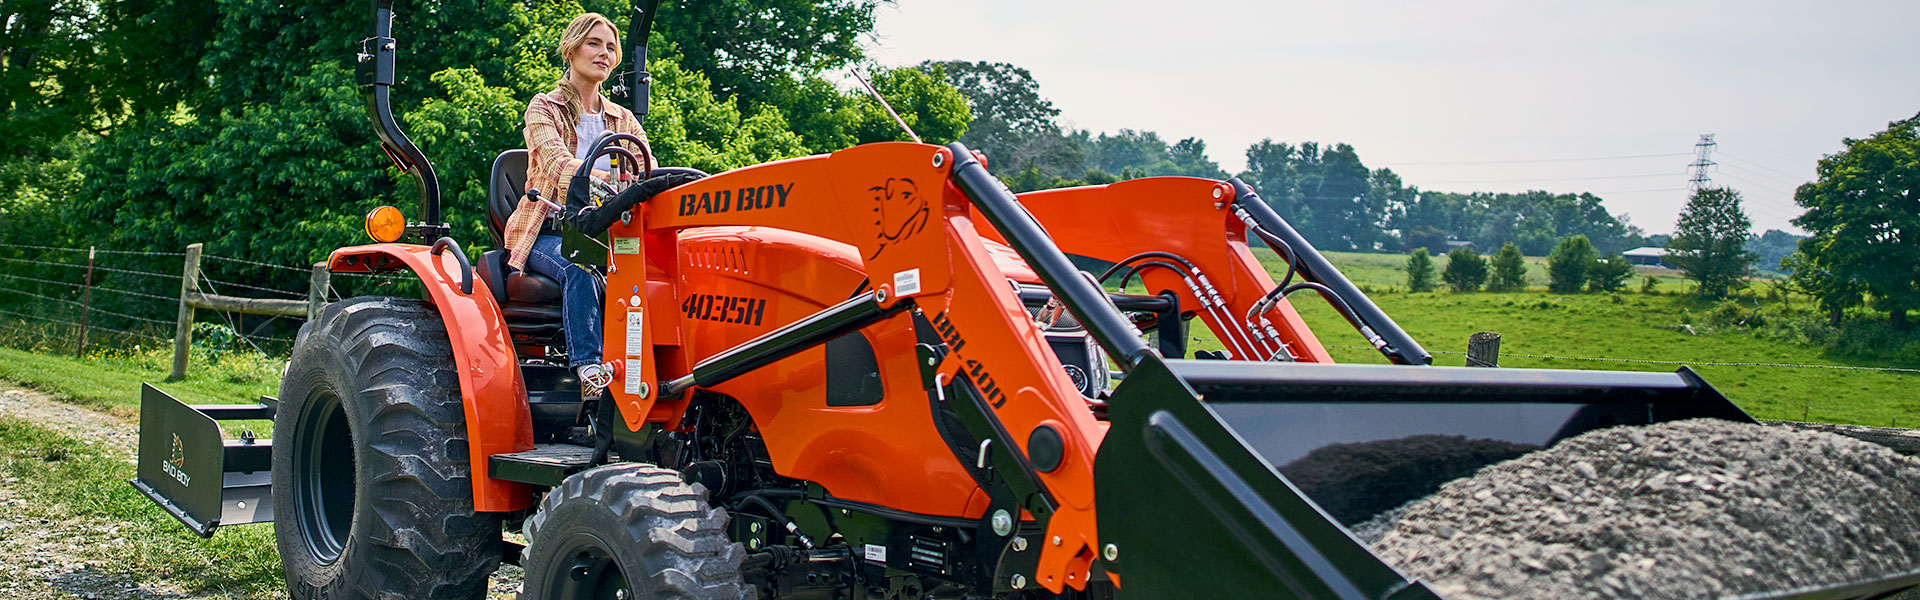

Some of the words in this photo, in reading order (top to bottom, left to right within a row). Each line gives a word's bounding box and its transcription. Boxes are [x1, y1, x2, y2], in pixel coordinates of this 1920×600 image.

[679, 190, 731, 216] BAD
[736, 183, 795, 211] BOY
[682, 293, 766, 326] 4035H
[933, 311, 966, 360] BBL
[966, 359, 1007, 409] 400
[163, 460, 177, 478] BAD
[177, 470, 191, 487] BOY
